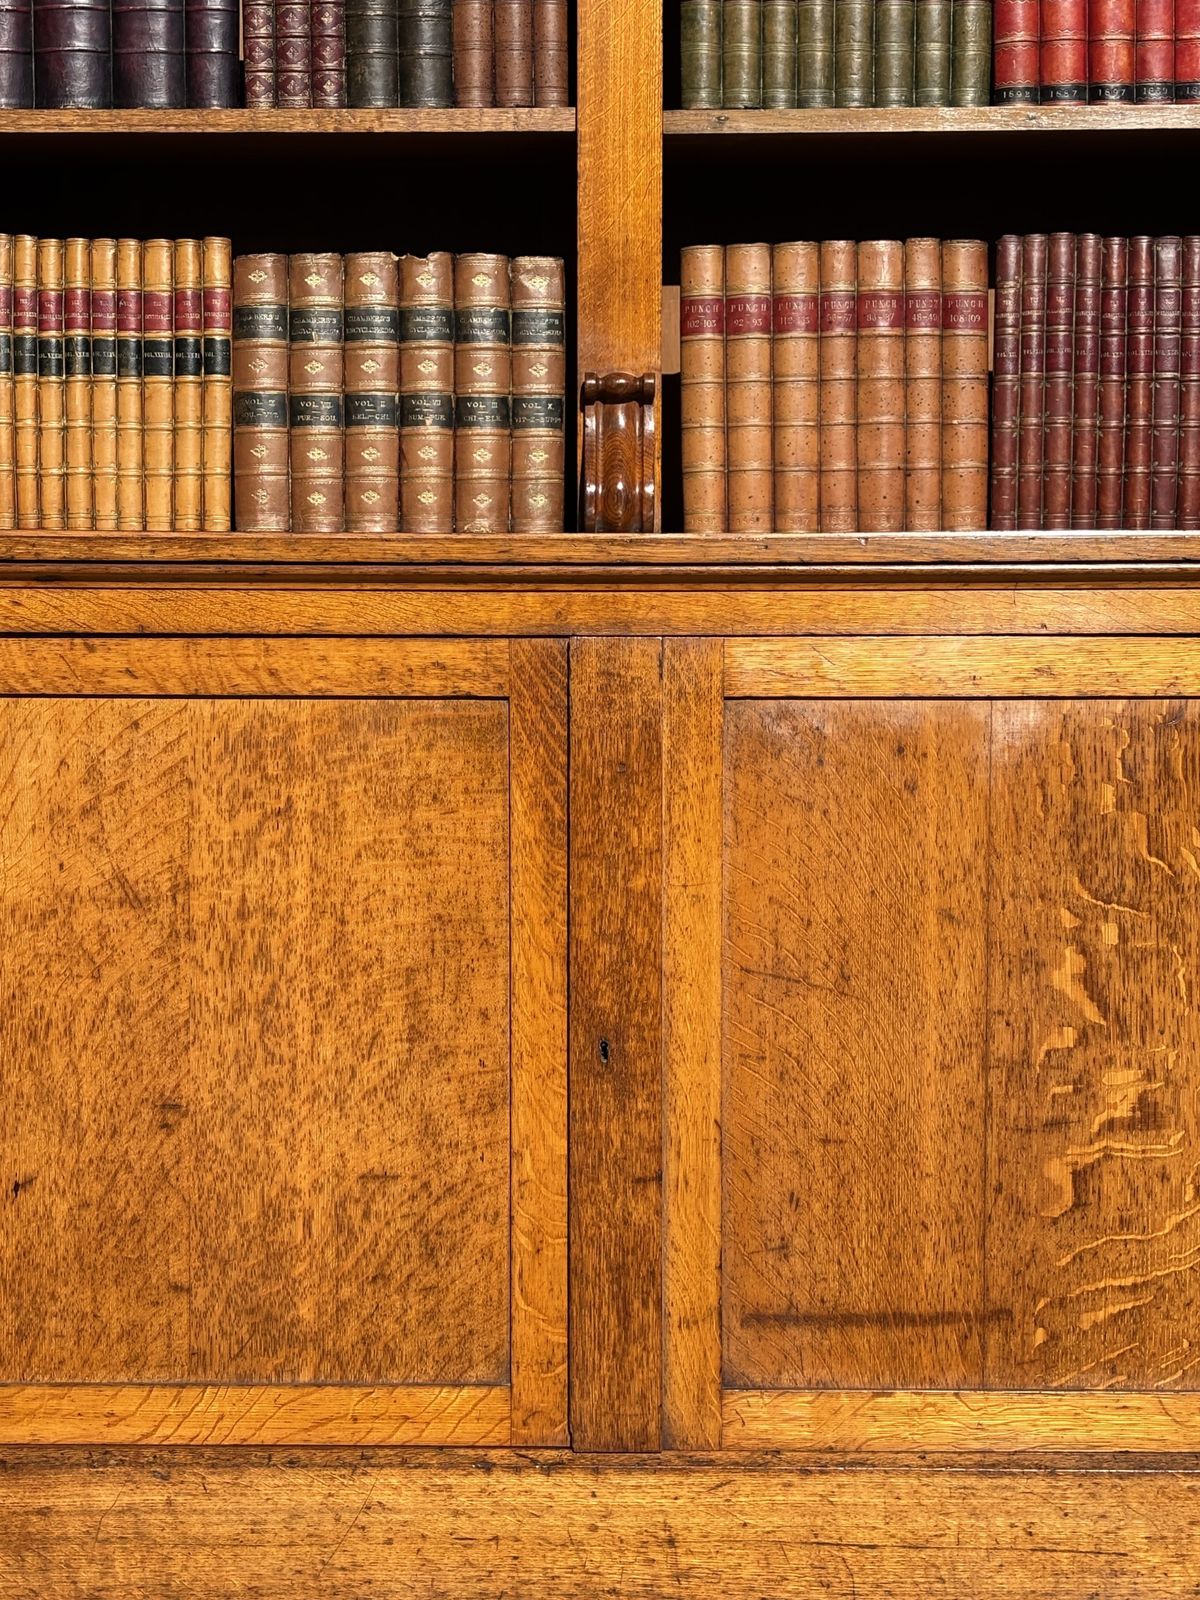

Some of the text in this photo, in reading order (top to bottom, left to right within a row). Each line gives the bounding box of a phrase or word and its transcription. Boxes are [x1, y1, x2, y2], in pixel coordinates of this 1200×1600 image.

[1050, 89, 1078, 98] 1887
[1098, 88, 1126, 97] 1897
[685, 304, 719, 313] PUNCH
[731, 303, 767, 312] PUNCH
[824, 301, 855, 310] PUNCH
[865, 299, 897, 309] PUNCH
[948, 300, 984, 309] PUNCH
